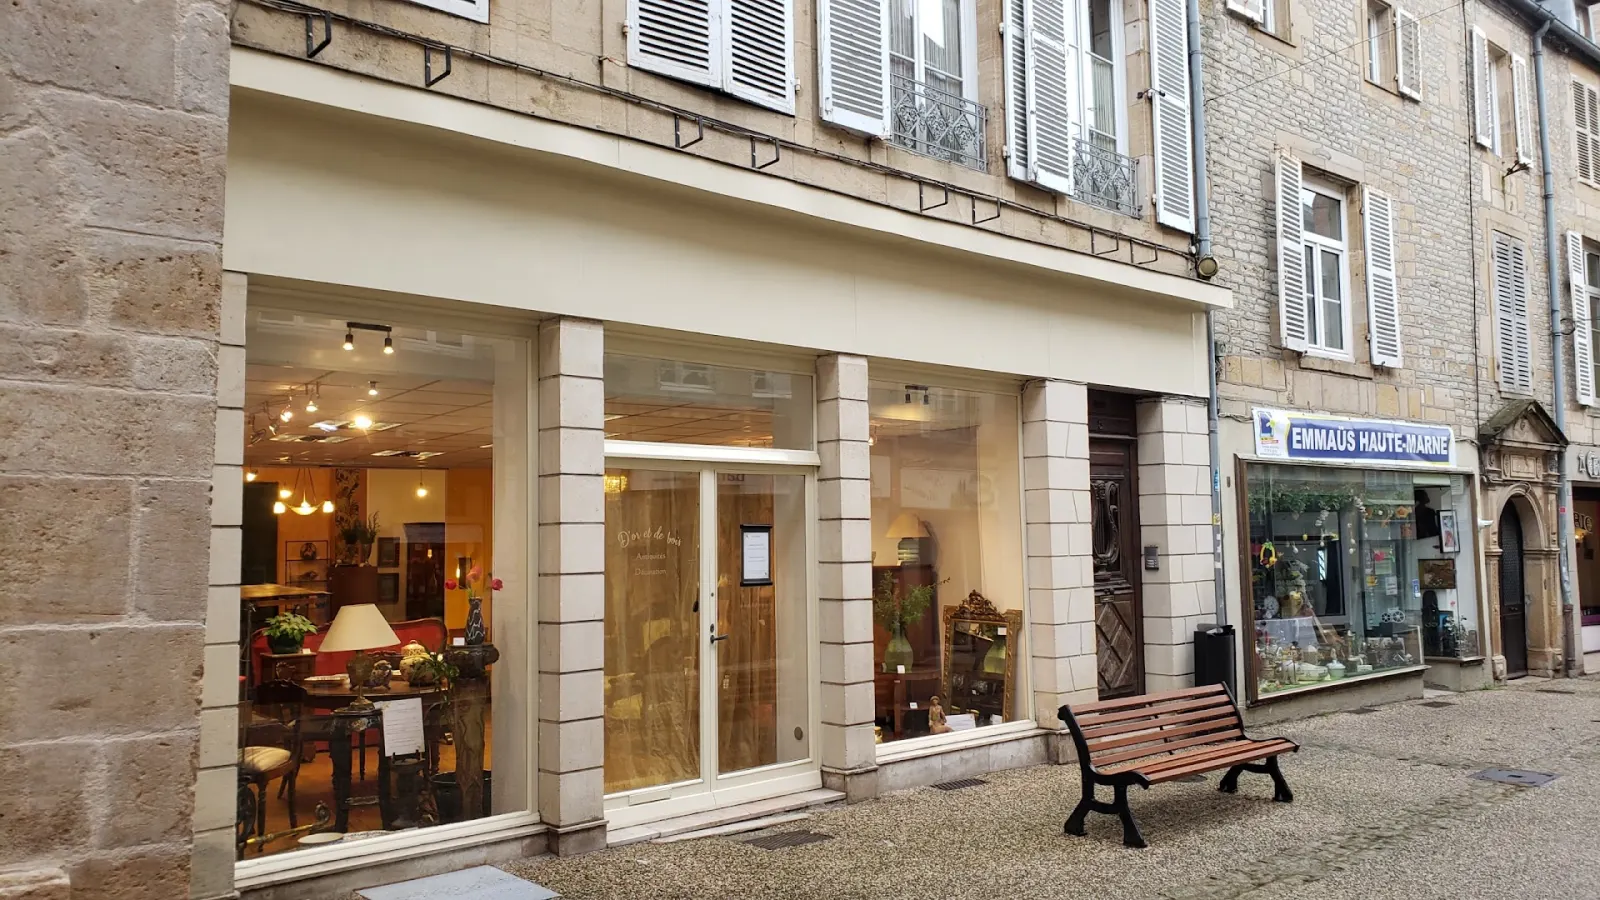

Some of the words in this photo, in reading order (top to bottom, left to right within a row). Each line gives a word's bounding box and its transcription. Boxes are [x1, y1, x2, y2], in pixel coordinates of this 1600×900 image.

[1292, 425, 1356, 452] EMMAÜS
[1359, 431, 1448, 455] HAUTE-MARNE
[617, 530, 641, 548] D'or
[643, 526, 653, 538] et
[653, 525, 665, 540] de
[667, 531, 682, 547] bois
